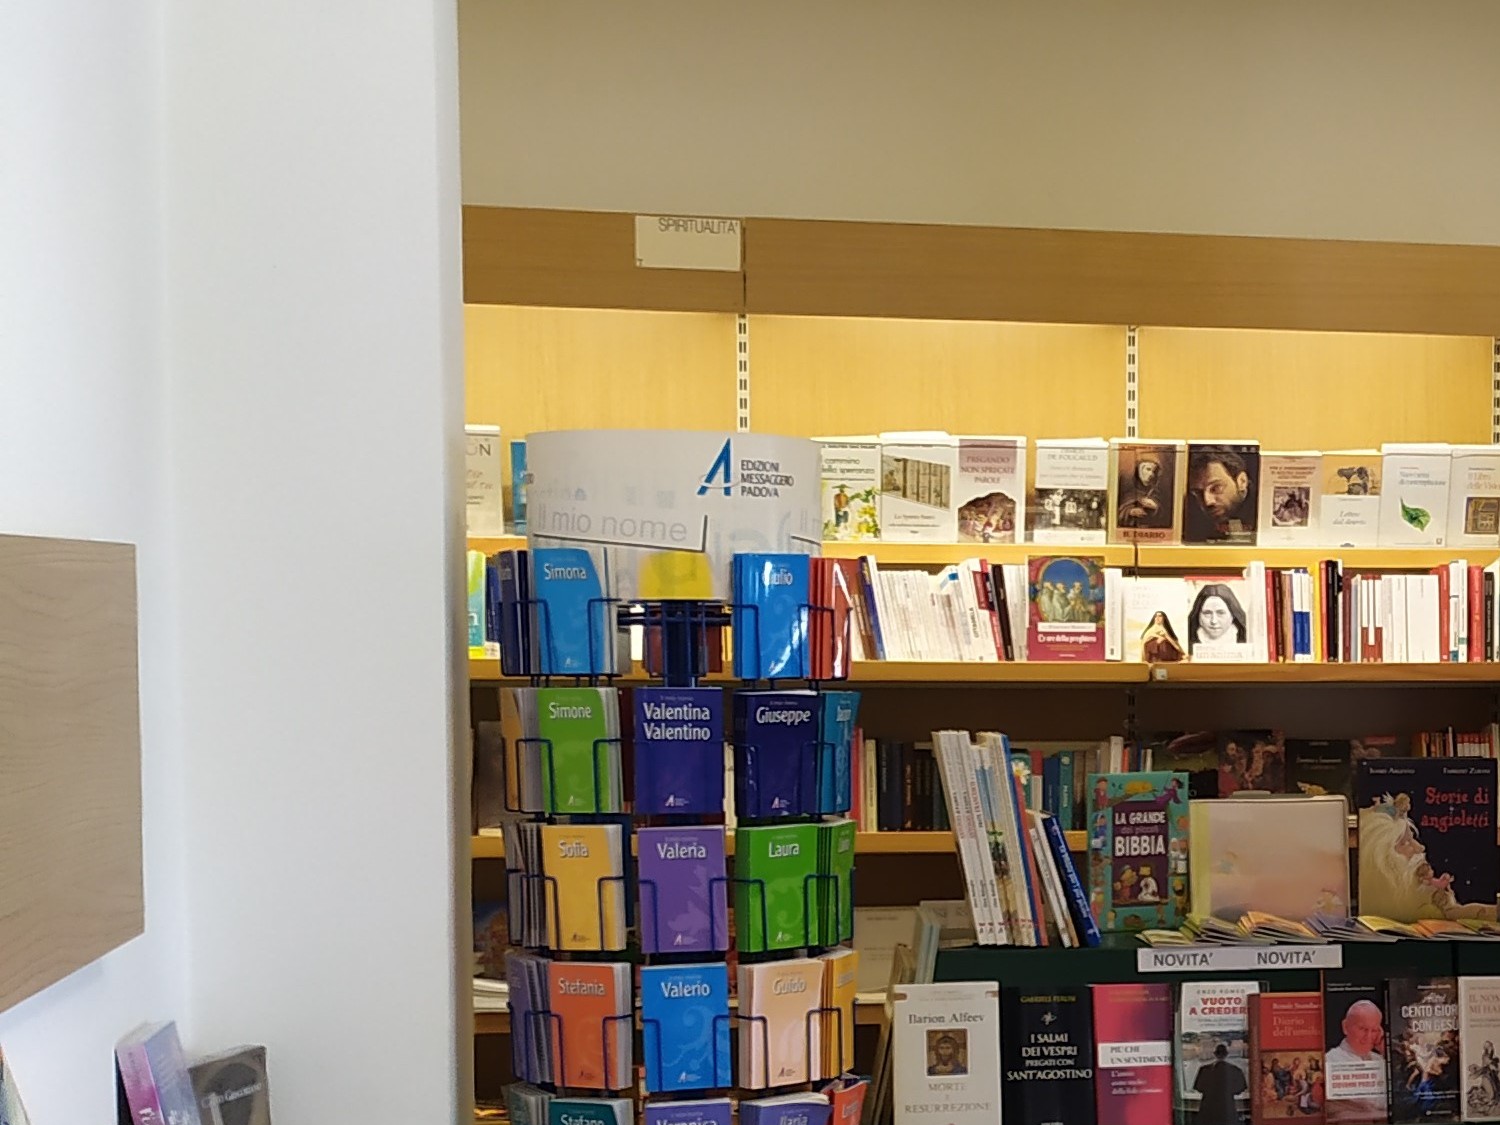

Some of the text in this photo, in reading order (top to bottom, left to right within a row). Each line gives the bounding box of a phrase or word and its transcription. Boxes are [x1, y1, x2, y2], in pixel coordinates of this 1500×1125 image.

[658, 218, 737, 235] SPIRITUALITA'
[741, 460, 779, 472] EDIZIONI
[741, 474, 794, 486] MESSAGGERO
[741, 487, 779, 497] PADOVA
[538, 504, 687, 542] Il mio nome
[544, 564, 587, 581] Simona
[549, 704, 592, 720] Simone
[644, 704, 710, 721] Valentina
[756, 707, 811, 724] Giuseppe
[645, 724, 711, 741] Valentino
[1424, 786, 1489, 805] Storie di
[1114, 812, 1166, 824] LA GRANDE
[1420, 813, 1489, 833] angioletti
[559, 842, 588, 858] Sofia
[657, 843, 706, 860] Valeria
[768, 843, 800, 858] Laura
[1114, 836, 1166, 857] BIBBIA
[1153, 953, 1214, 967] NOVITA'
[1257, 951, 1316, 965] NOVITA'
[559, 978, 606, 996] Stefania
[661, 982, 710, 998] Valerio
[1201, 997, 1242, 1005] VUOTO
[908, 1013, 985, 1024] Ilarion Alfeev
[1189, 1007, 1198, 1016] A
[1401, 1005, 1433, 1018] CENTO
[1412, 1020, 1432, 1032] CON
[1037, 1034, 1068, 1043] SALMI
[1022, 1047, 1077, 1057] DEI VESPRI
[1007, 1070, 1092, 1081] SANT'AGOSTINO
[904, 1103, 989, 1113] RESURREZIONE
